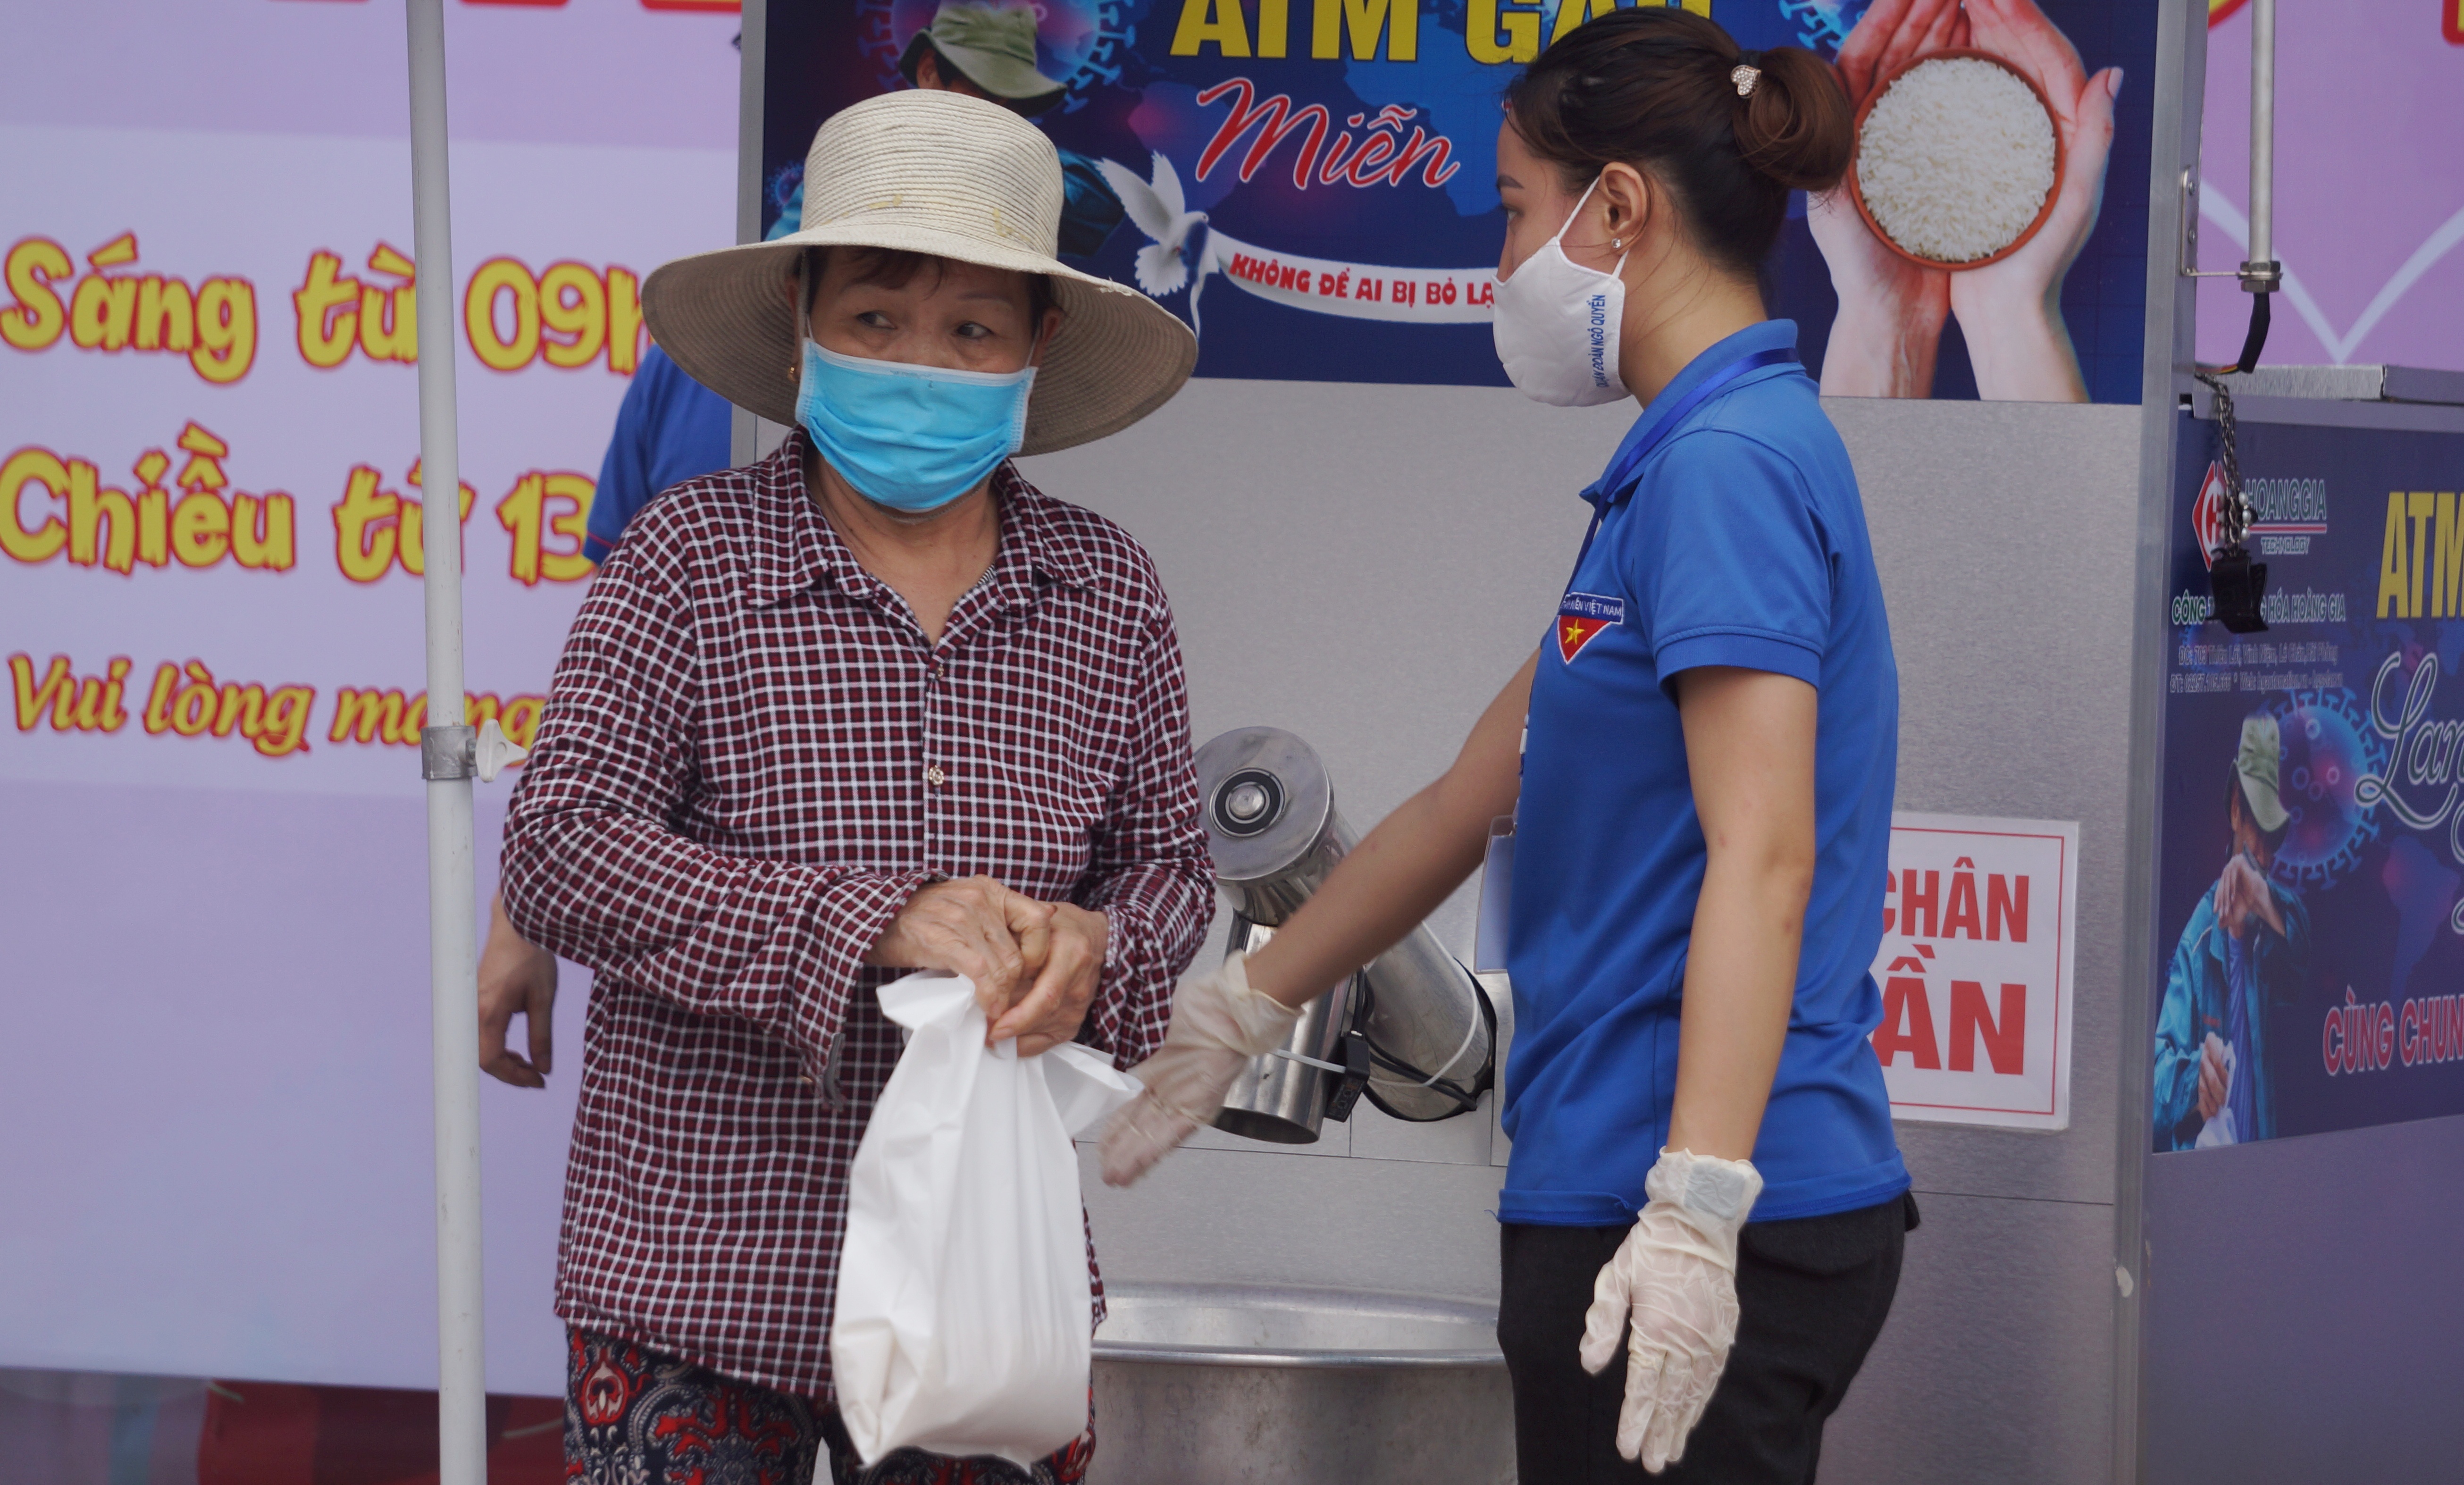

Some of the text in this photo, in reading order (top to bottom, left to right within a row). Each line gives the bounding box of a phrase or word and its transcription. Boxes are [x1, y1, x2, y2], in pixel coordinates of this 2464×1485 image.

[1196, 76, 1461, 190] Miễn
[0, 231, 258, 385] Sáng
[1229, 252, 1311, 293] KHÔNG
[1318, 267, 1350, 298] ĐỂ
[1355, 277, 1382, 302] AI
[1392, 280, 1416, 308] BỊ
[1425, 277, 1457, 305] BỎ
[1586, 294, 1606, 326] QUYỀN
[1587, 327, 1604, 346] NGÔ
[1588, 347, 1604, 371] ĐOÀN
[0, 421, 295, 577] Chiều
[2261, 537, 2310, 555] TECHNOLOGY
[2376, 491, 2464, 619] ATM
[1584, 599, 1602, 615] VIỆT
[1603, 604, 1622, 616] NAM
[2171, 588, 2206, 625] CÔNG
[2268, 586, 2289, 624] HÓA
[2292, 586, 2327, 623] HOÀNG
[2328, 593, 2346, 622] GIA
[12, 653, 133, 734] Vui
[143, 658, 316, 758] lòng
[2322, 983, 2464, 1077] CÙNG CHUN
